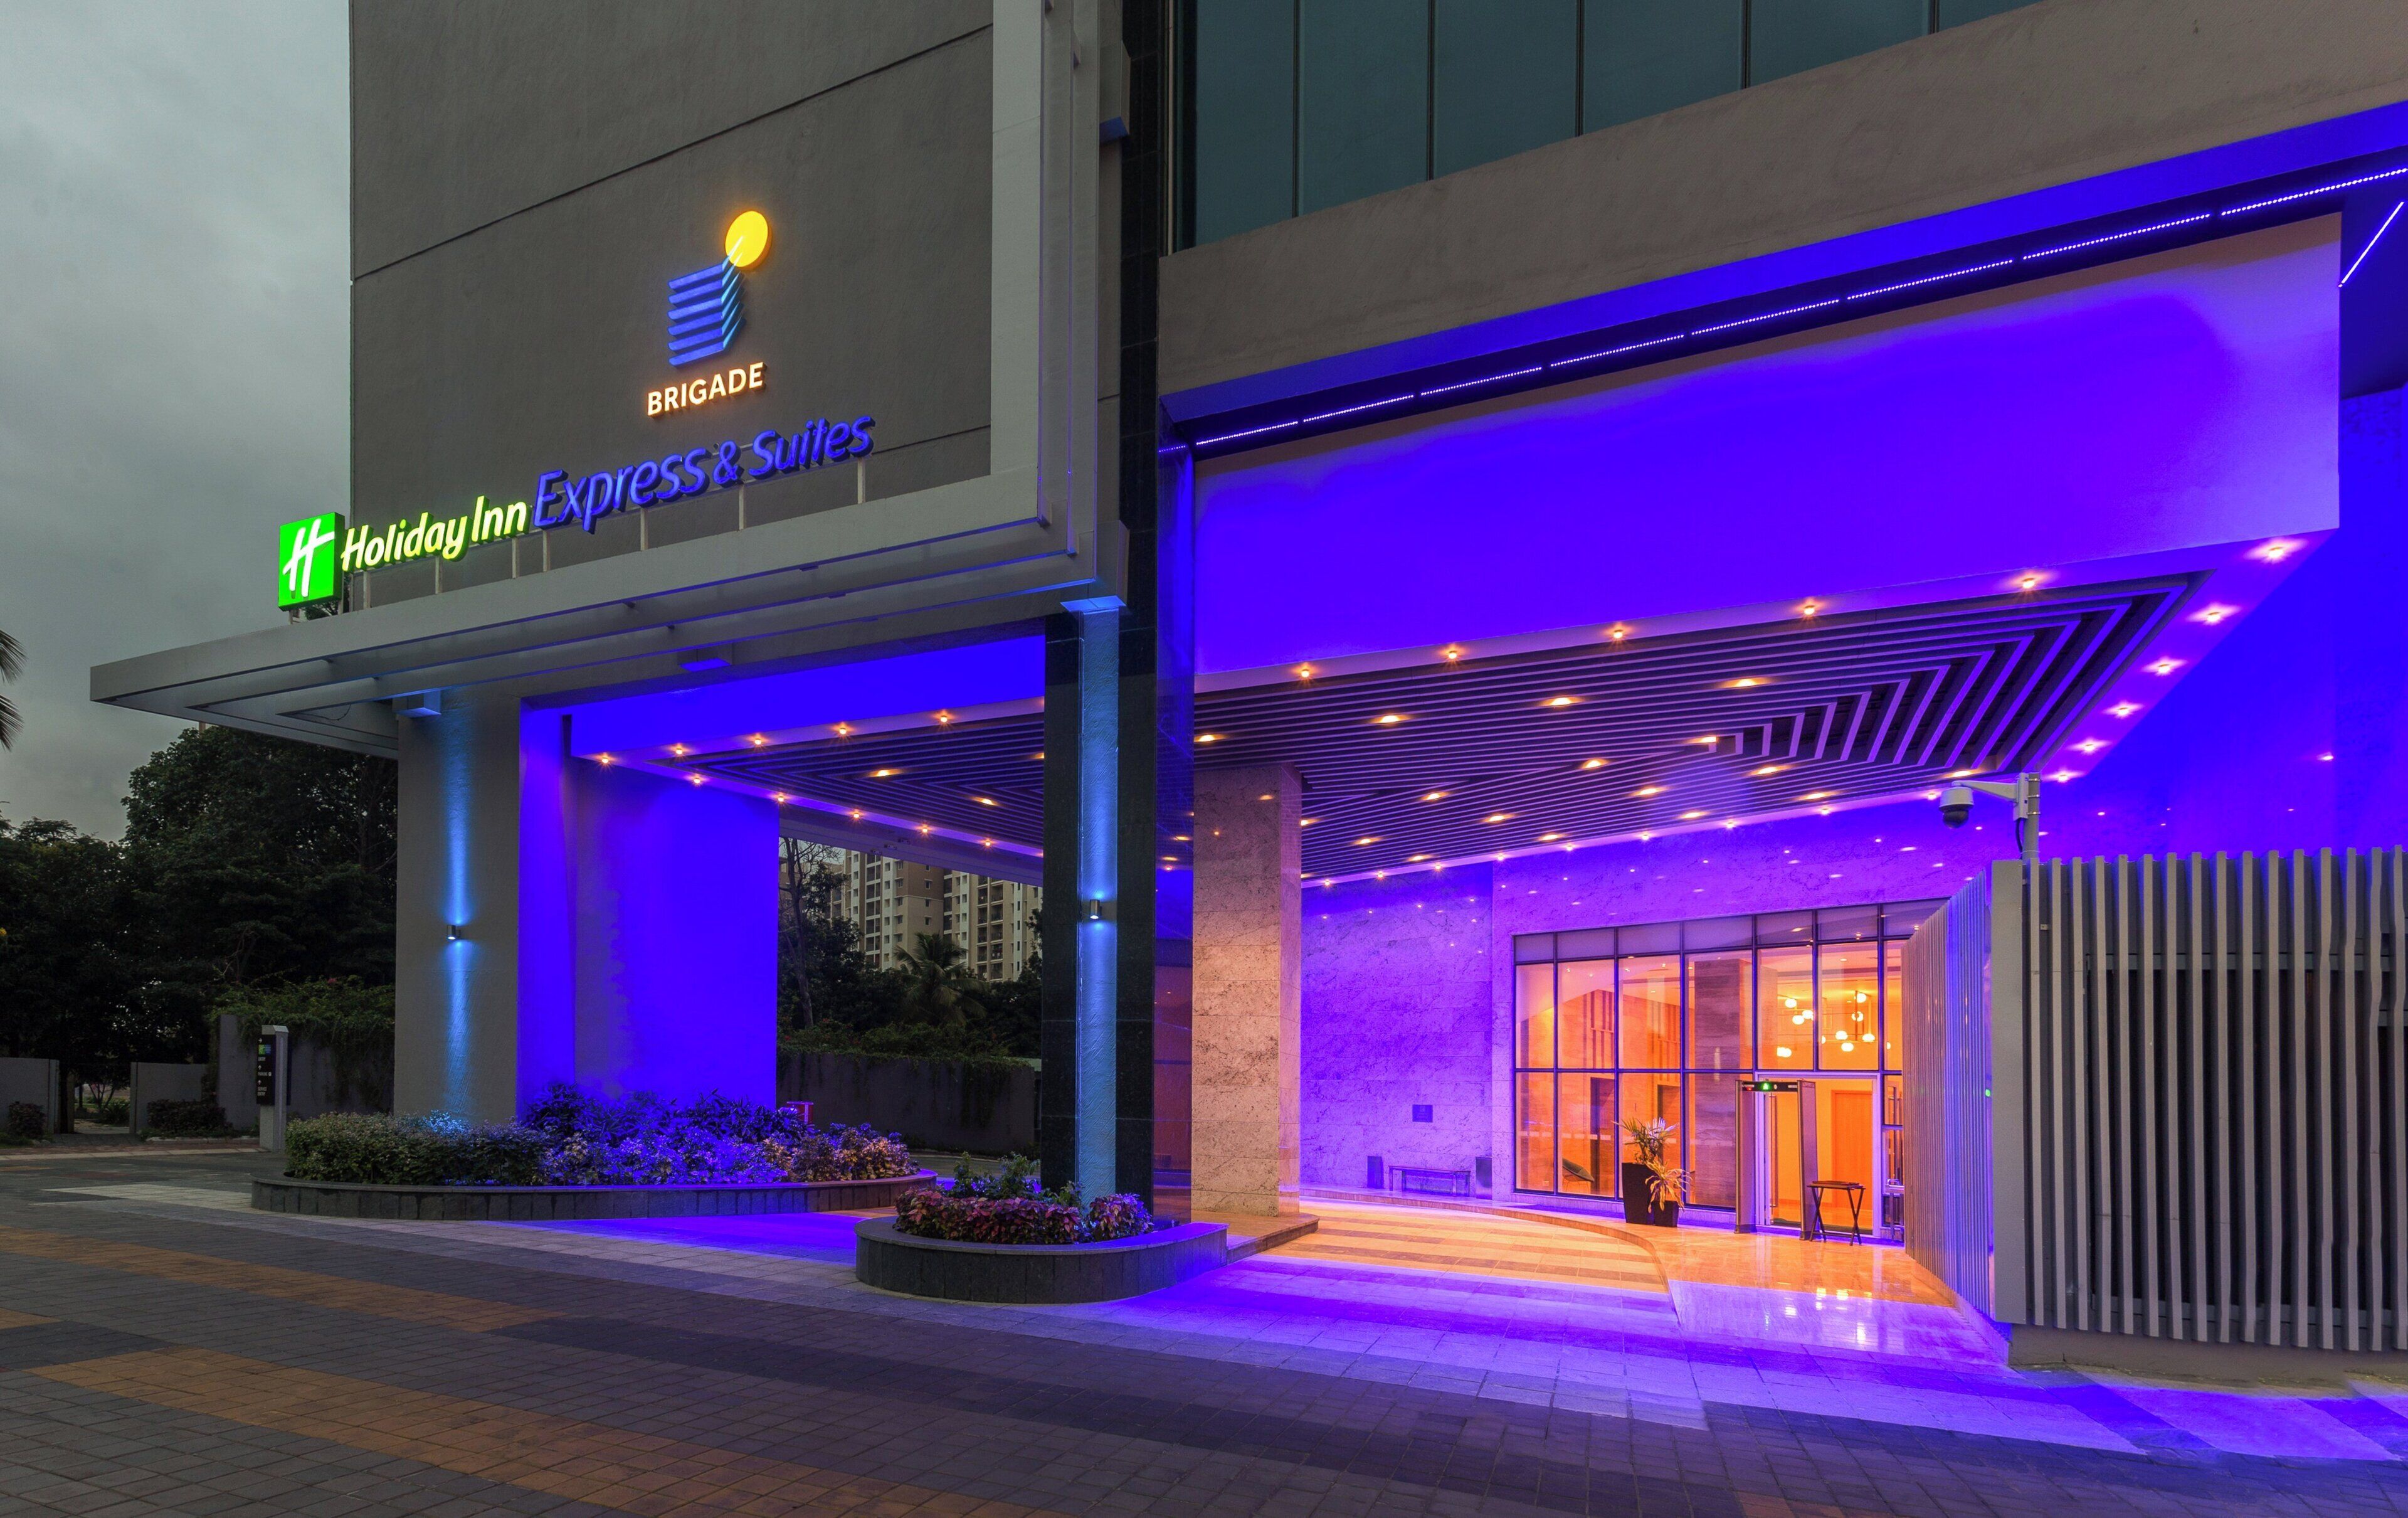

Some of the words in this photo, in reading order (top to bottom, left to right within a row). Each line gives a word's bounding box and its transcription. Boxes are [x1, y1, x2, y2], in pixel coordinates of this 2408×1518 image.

[647, 362, 764, 416] BRIGADE
[341, 512, 470, 571] Holiday
[472, 495, 528, 543] Inn
[533, 447, 709, 534] Express
[712, 440, 742, 487] &
[749, 416, 875, 479] Suites
